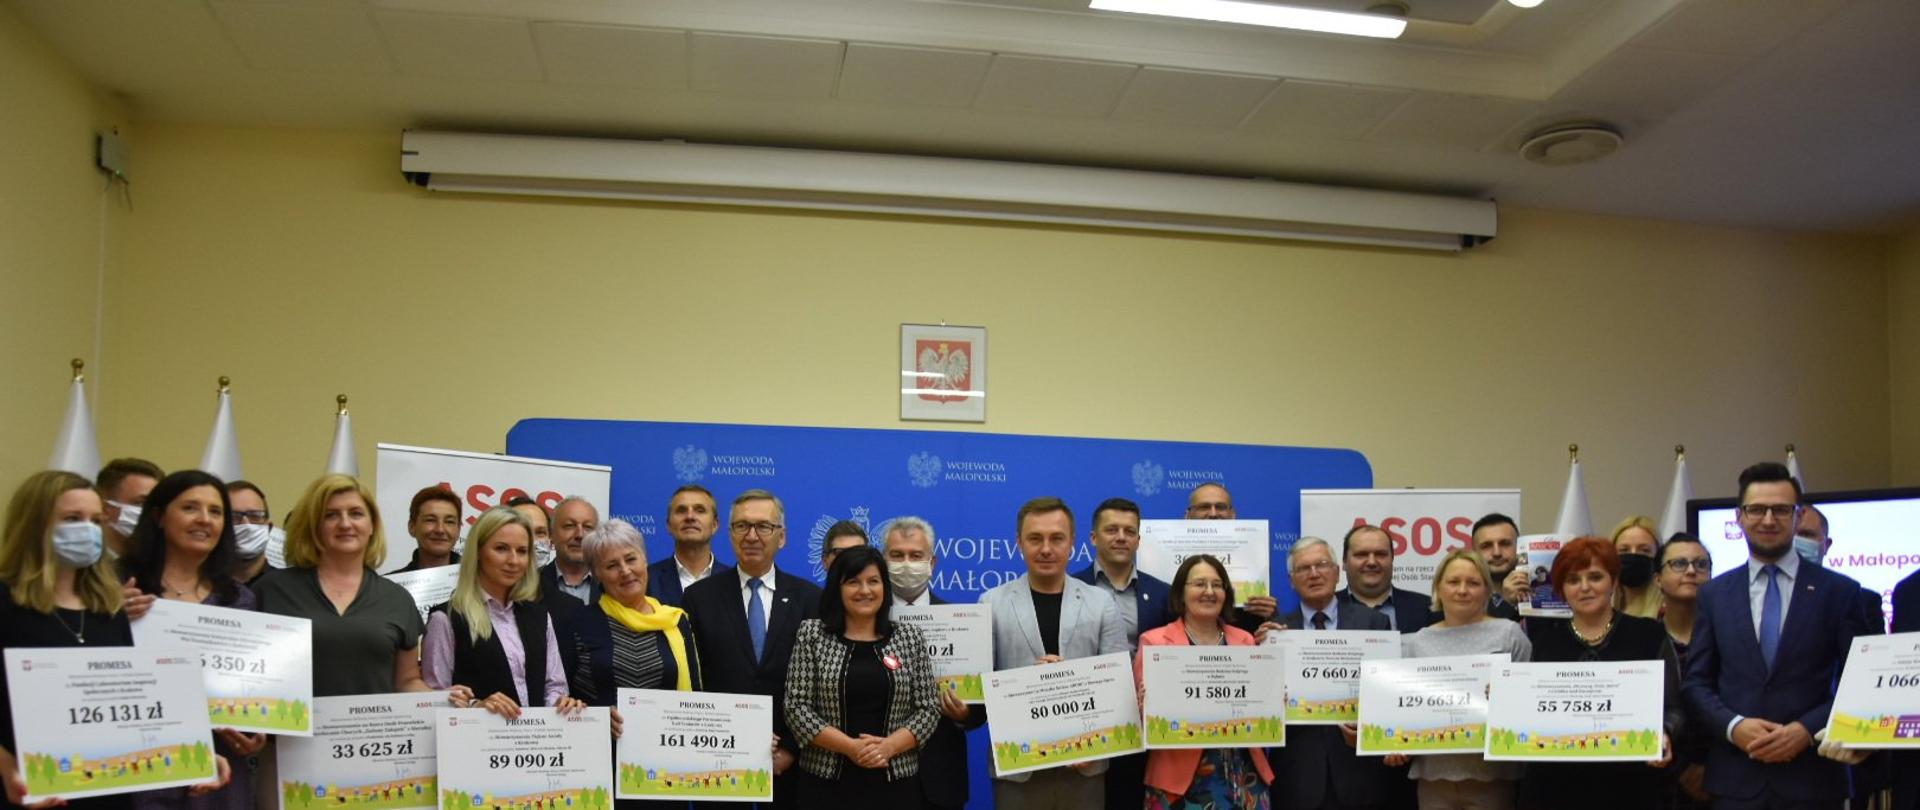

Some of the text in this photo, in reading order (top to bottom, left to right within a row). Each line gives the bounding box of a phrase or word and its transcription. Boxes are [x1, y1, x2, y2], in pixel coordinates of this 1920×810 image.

[713, 454, 775, 465] WOJEWODA
[711, 466, 776, 477] MAŁOPOLSKI
[947, 461, 1005, 471] WOJEWODA
[945, 472, 1006, 482] MAŁOPOLSKI
[1168, 470, 1224, 479] WOJEWODA
[1829, 557, 1844, 567] w
[198, 615, 242, 628] PROMESA
[899, 614, 934, 622] PROMESA
[941, 643, 954, 656] zł
[87, 661, 132, 671] PROMESA
[211, 654, 245, 671] 350
[250, 658, 265, 674] zł
[1040, 669, 1075, 680] PROMESA
[1302, 667, 1318, 679] 67
[1322, 667, 1347, 679] 660
[1556, 670, 1595, 678] PROMESA
[1874, 673, 1920, 688] 1 066
[1185, 685, 1246, 699] 91 580 zł
[679, 701, 716, 710] PROMESA
[1398, 692, 1470, 708] 129 663 zł
[1537, 699, 1611, 712] 55 758 zł
[69, 701, 163, 725] 126 131 zł
[349, 705, 392, 715] PROMESA
[1030, 706, 1049, 720] 80
[1052, 701, 1080, 717] 000
[1082, 697, 1096, 711] zł
[505, 717, 546, 726] PROMESA
[659, 733, 735, 749] 161 490 zł
[332, 739, 413, 759] 33 625 zł
[490, 752, 564, 769] 89 090 zł
